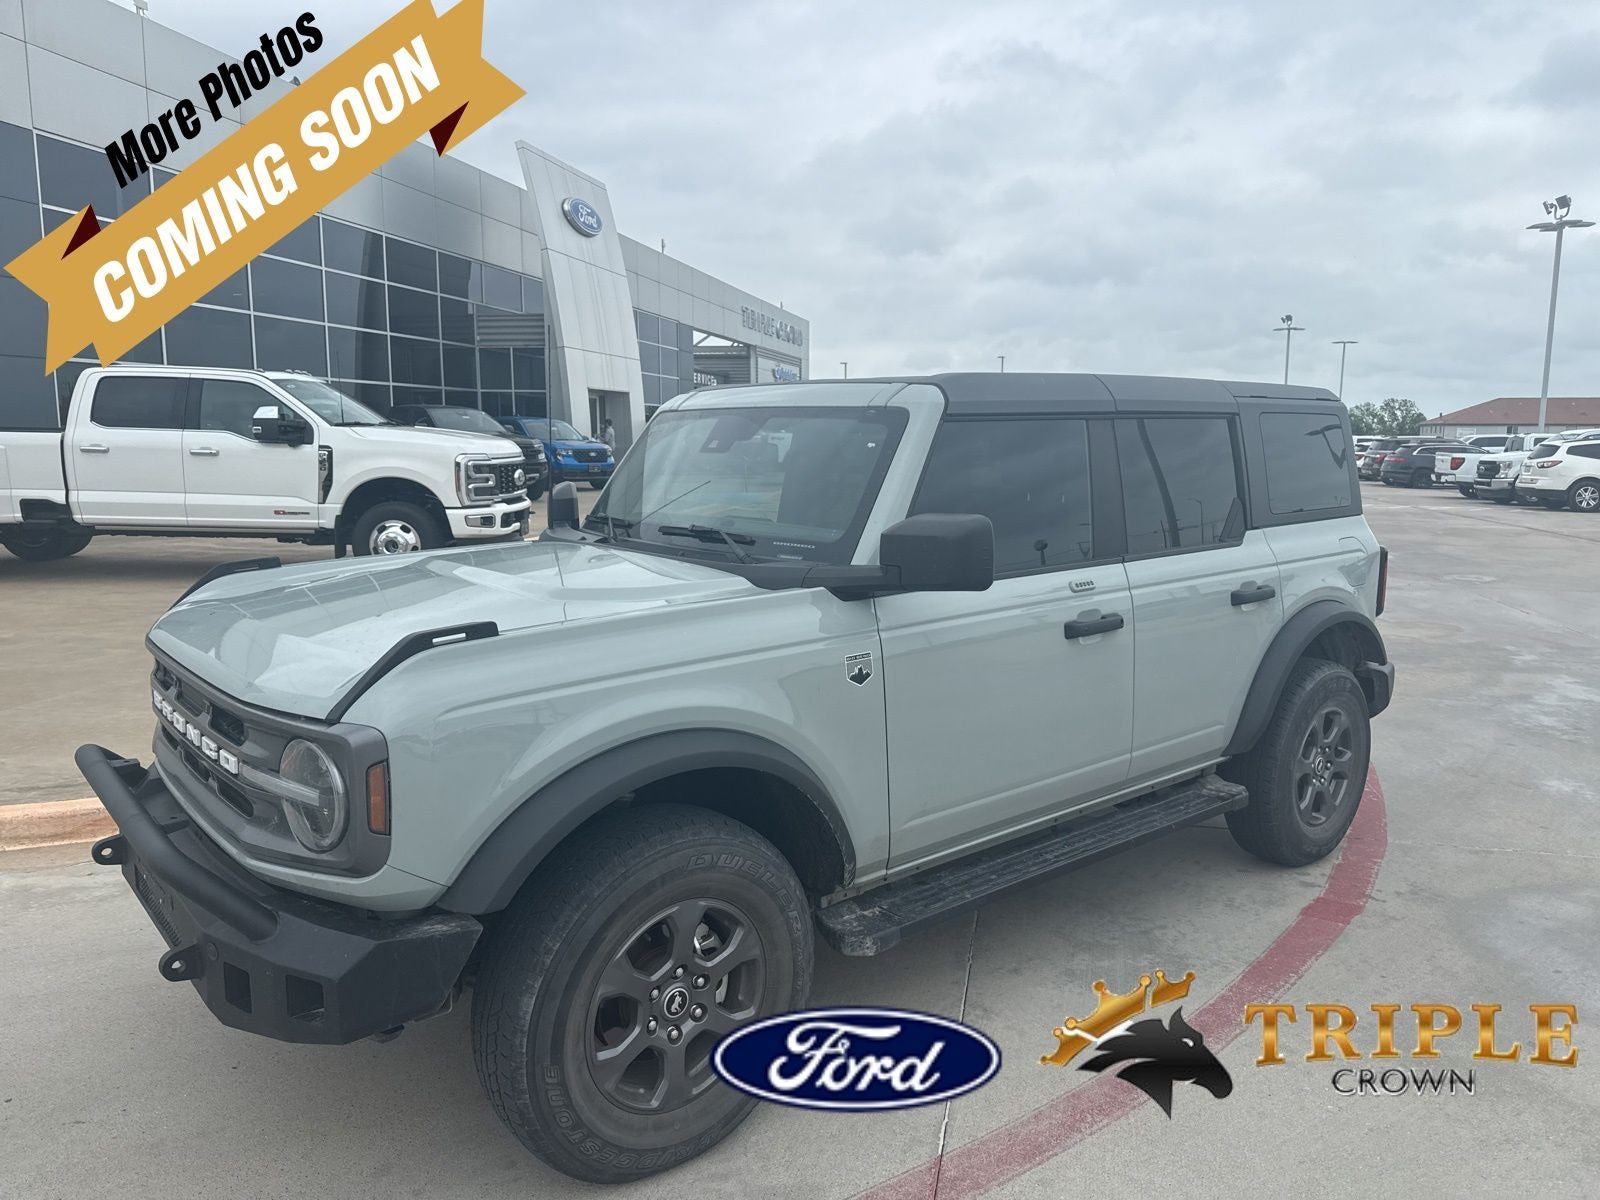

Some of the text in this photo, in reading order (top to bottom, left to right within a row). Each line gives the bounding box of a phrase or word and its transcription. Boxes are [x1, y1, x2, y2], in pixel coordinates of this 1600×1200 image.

[578, 204, 598, 228] Ford
[693, 372, 717, 386] ERVICE
[153, 690, 239, 774] BRONCO
[686, 852, 803, 935] DUELER
